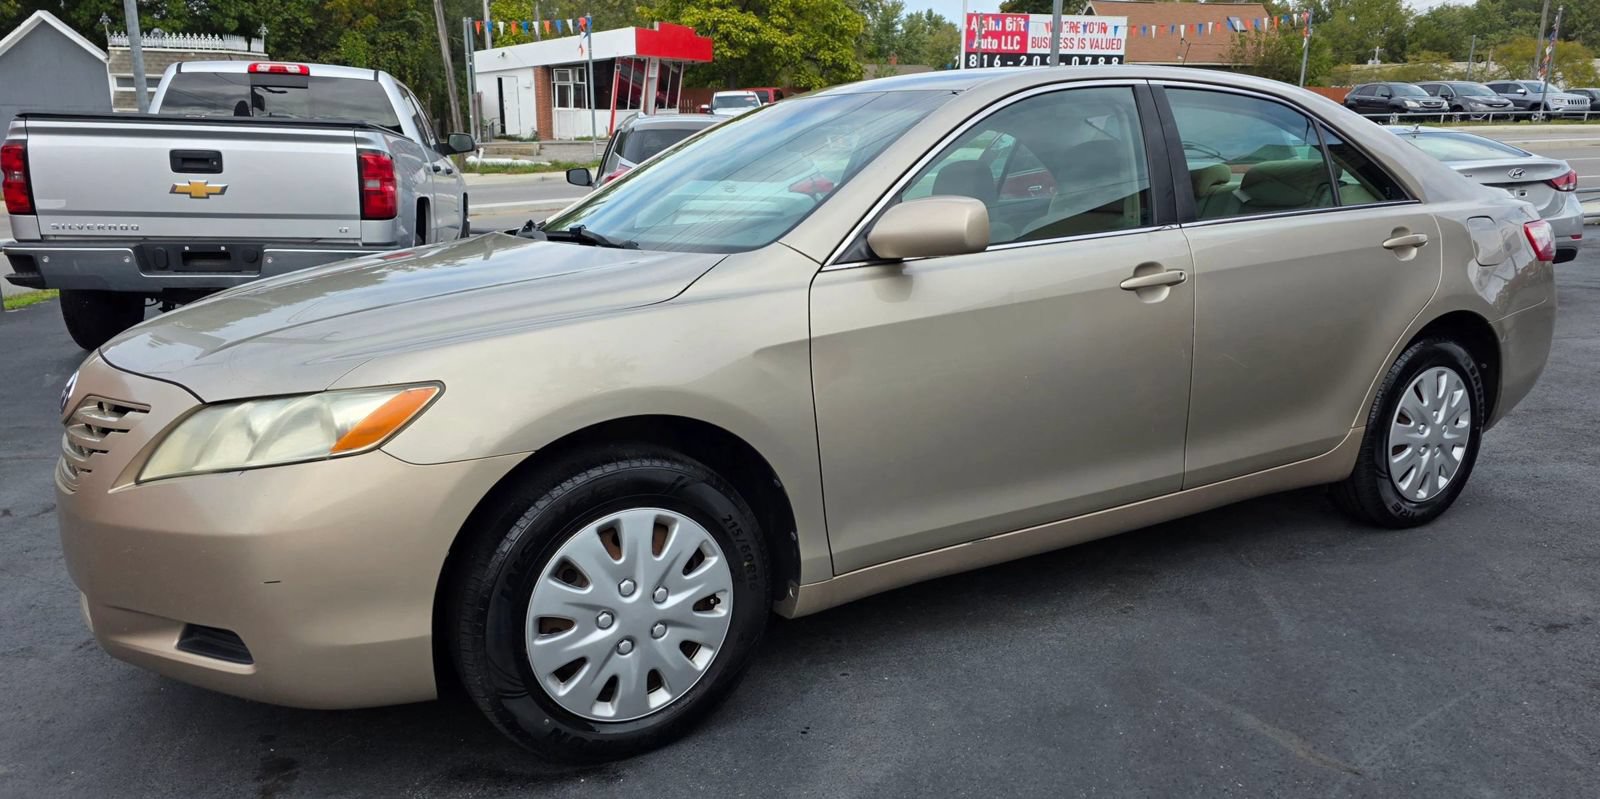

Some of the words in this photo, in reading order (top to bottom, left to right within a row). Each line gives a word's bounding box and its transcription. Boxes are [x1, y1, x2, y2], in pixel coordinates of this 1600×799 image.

[970, 16, 1002, 34] Apha
[1001, 35, 1021, 50] LLC
[1031, 37, 1075, 49] BUSIESS
[1077, 38, 1086, 50] IS
[1089, 38, 1122, 50] VALUED
[50, 223, 140, 231] SILVERADO
